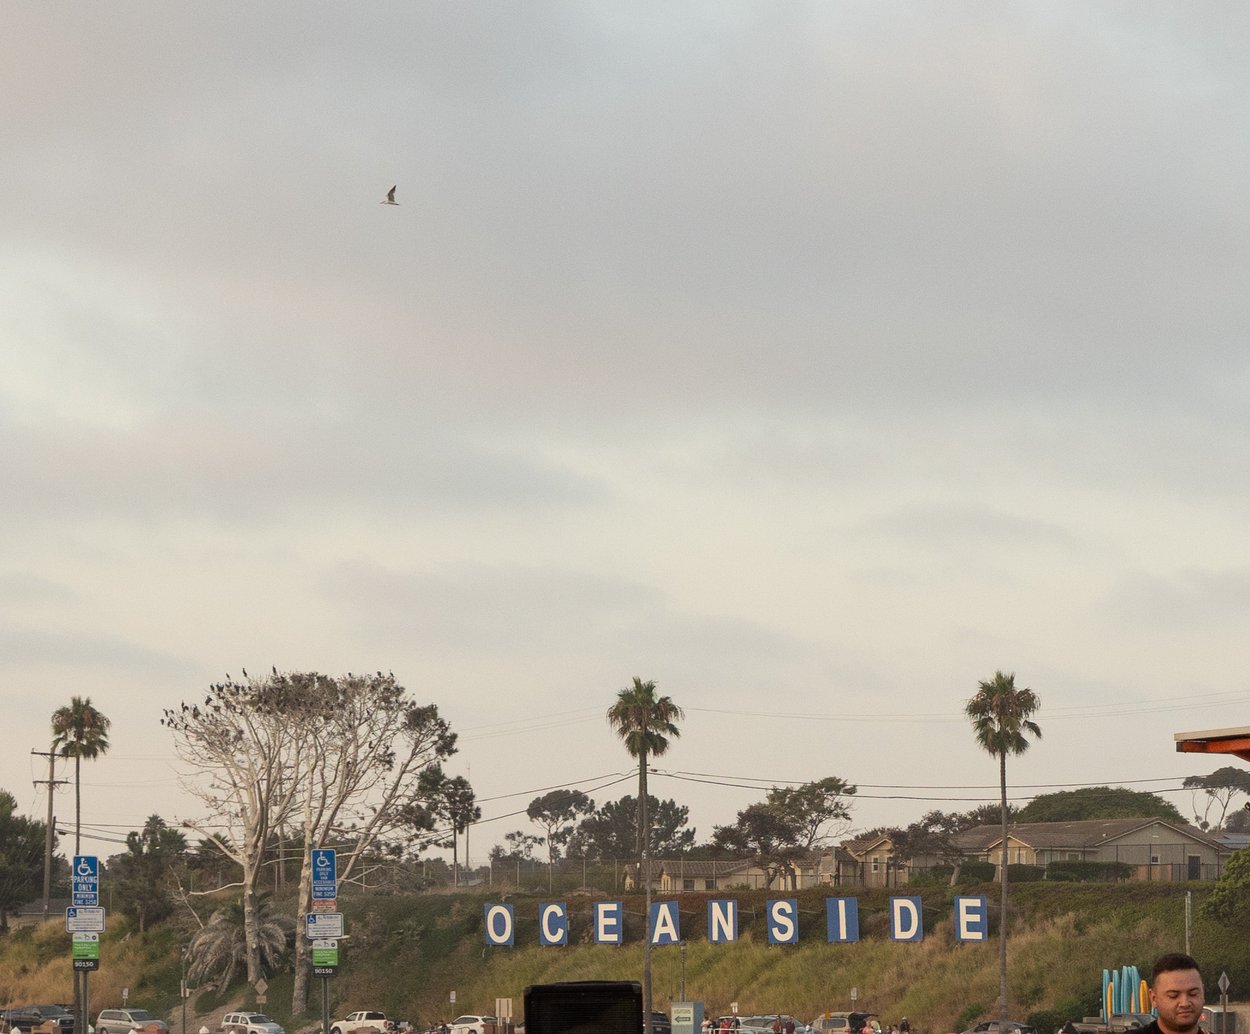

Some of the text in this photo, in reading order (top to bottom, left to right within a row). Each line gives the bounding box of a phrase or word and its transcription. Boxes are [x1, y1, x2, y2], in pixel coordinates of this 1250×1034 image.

[73, 875, 98, 884] PARKING
[77, 883, 93, 892] ONLY
[487, 898, 983, 944] OCEANSIDE
